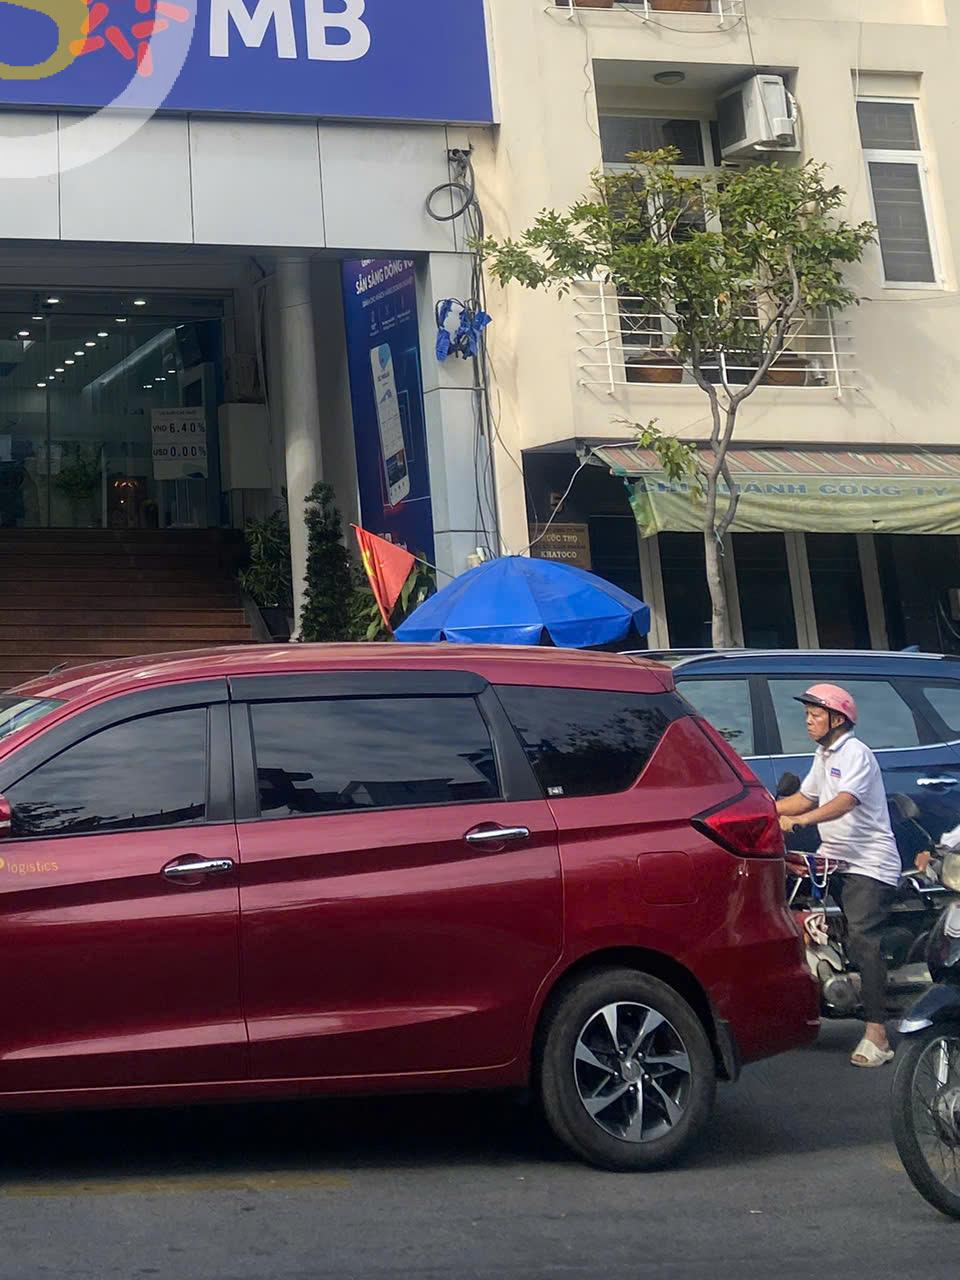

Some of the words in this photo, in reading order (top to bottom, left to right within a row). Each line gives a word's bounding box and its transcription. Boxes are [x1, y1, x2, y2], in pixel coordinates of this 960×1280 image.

[819, 482, 902, 496] CÔNG
[912, 486, 948, 497] TY
[540, 550, 578, 559] KHATOCO
[7, 860, 59, 875] logistics
